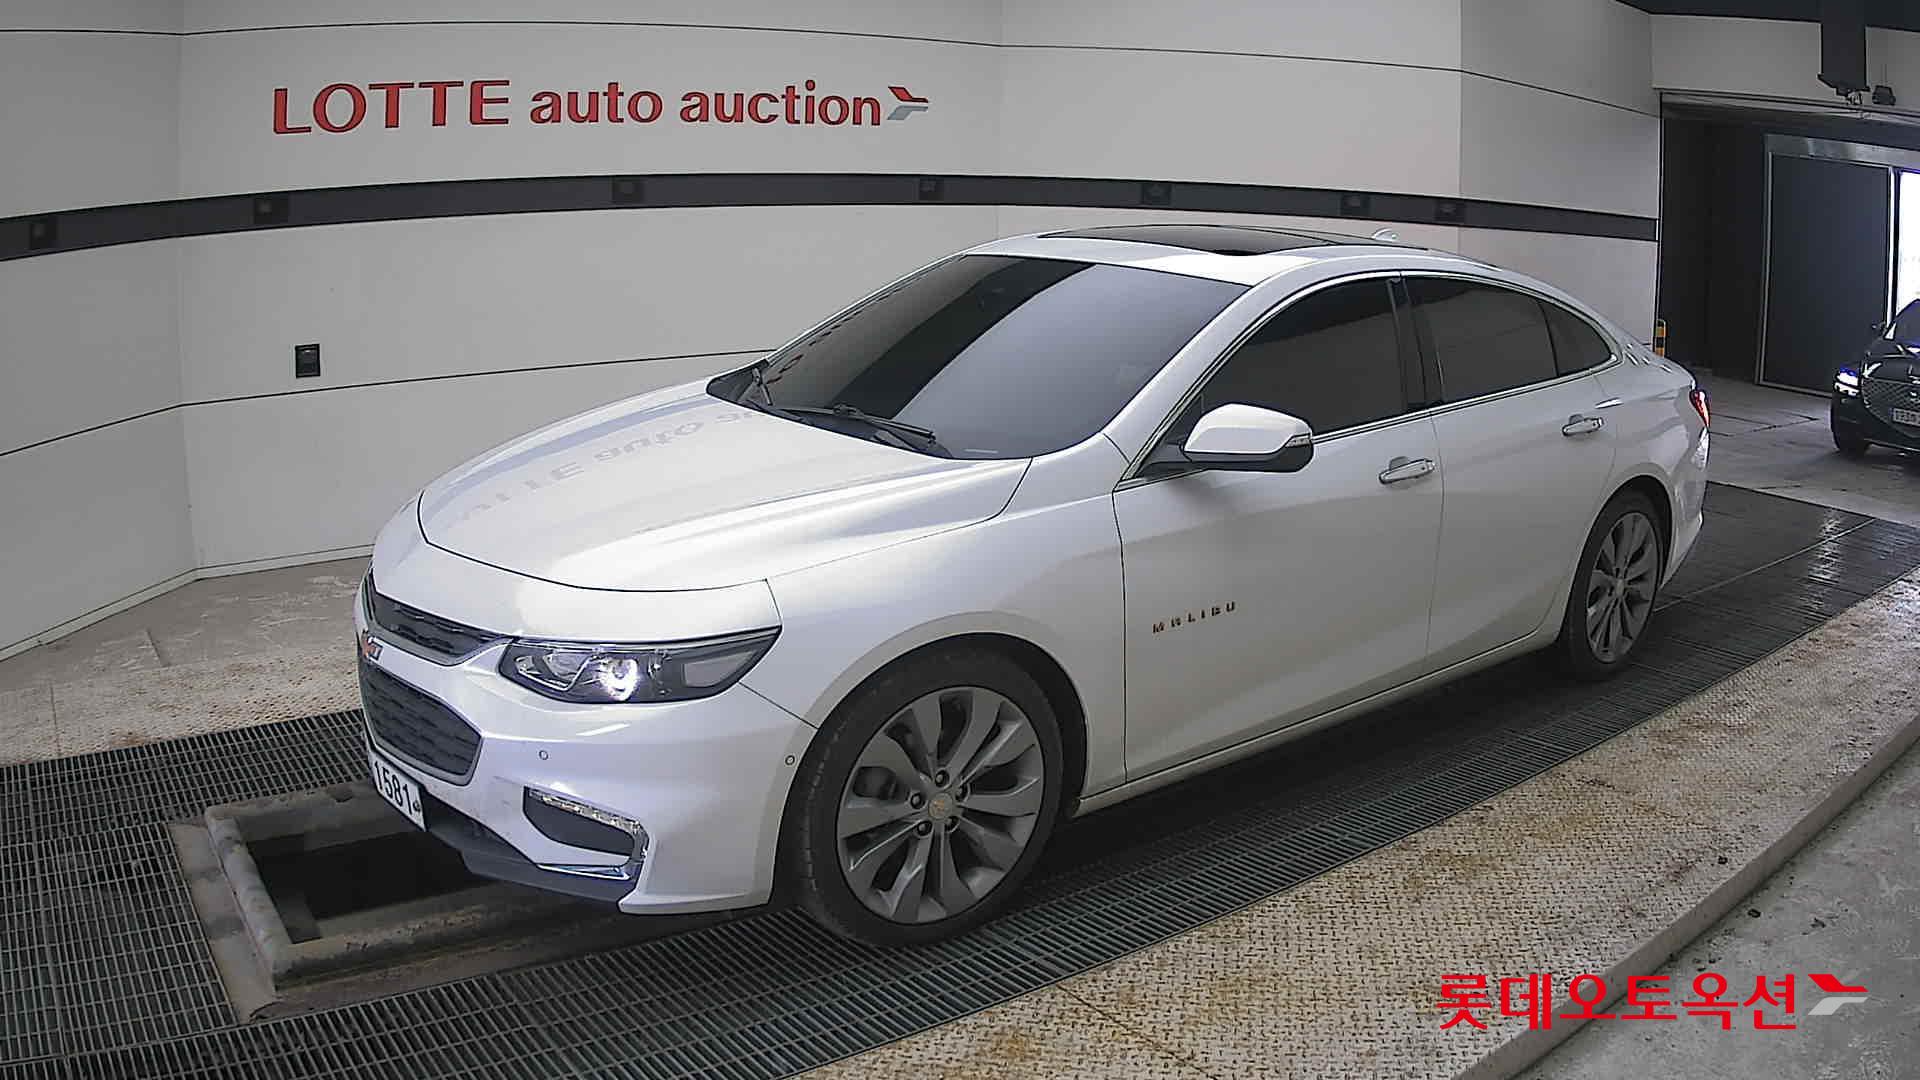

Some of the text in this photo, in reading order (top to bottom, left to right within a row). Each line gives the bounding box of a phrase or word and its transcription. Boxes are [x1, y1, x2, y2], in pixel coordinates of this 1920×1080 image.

[272, 79, 882, 135] LOTTE auto auction
[1152, 600, 1236, 634] MALIBU
[374, 760, 413, 816] 1581
